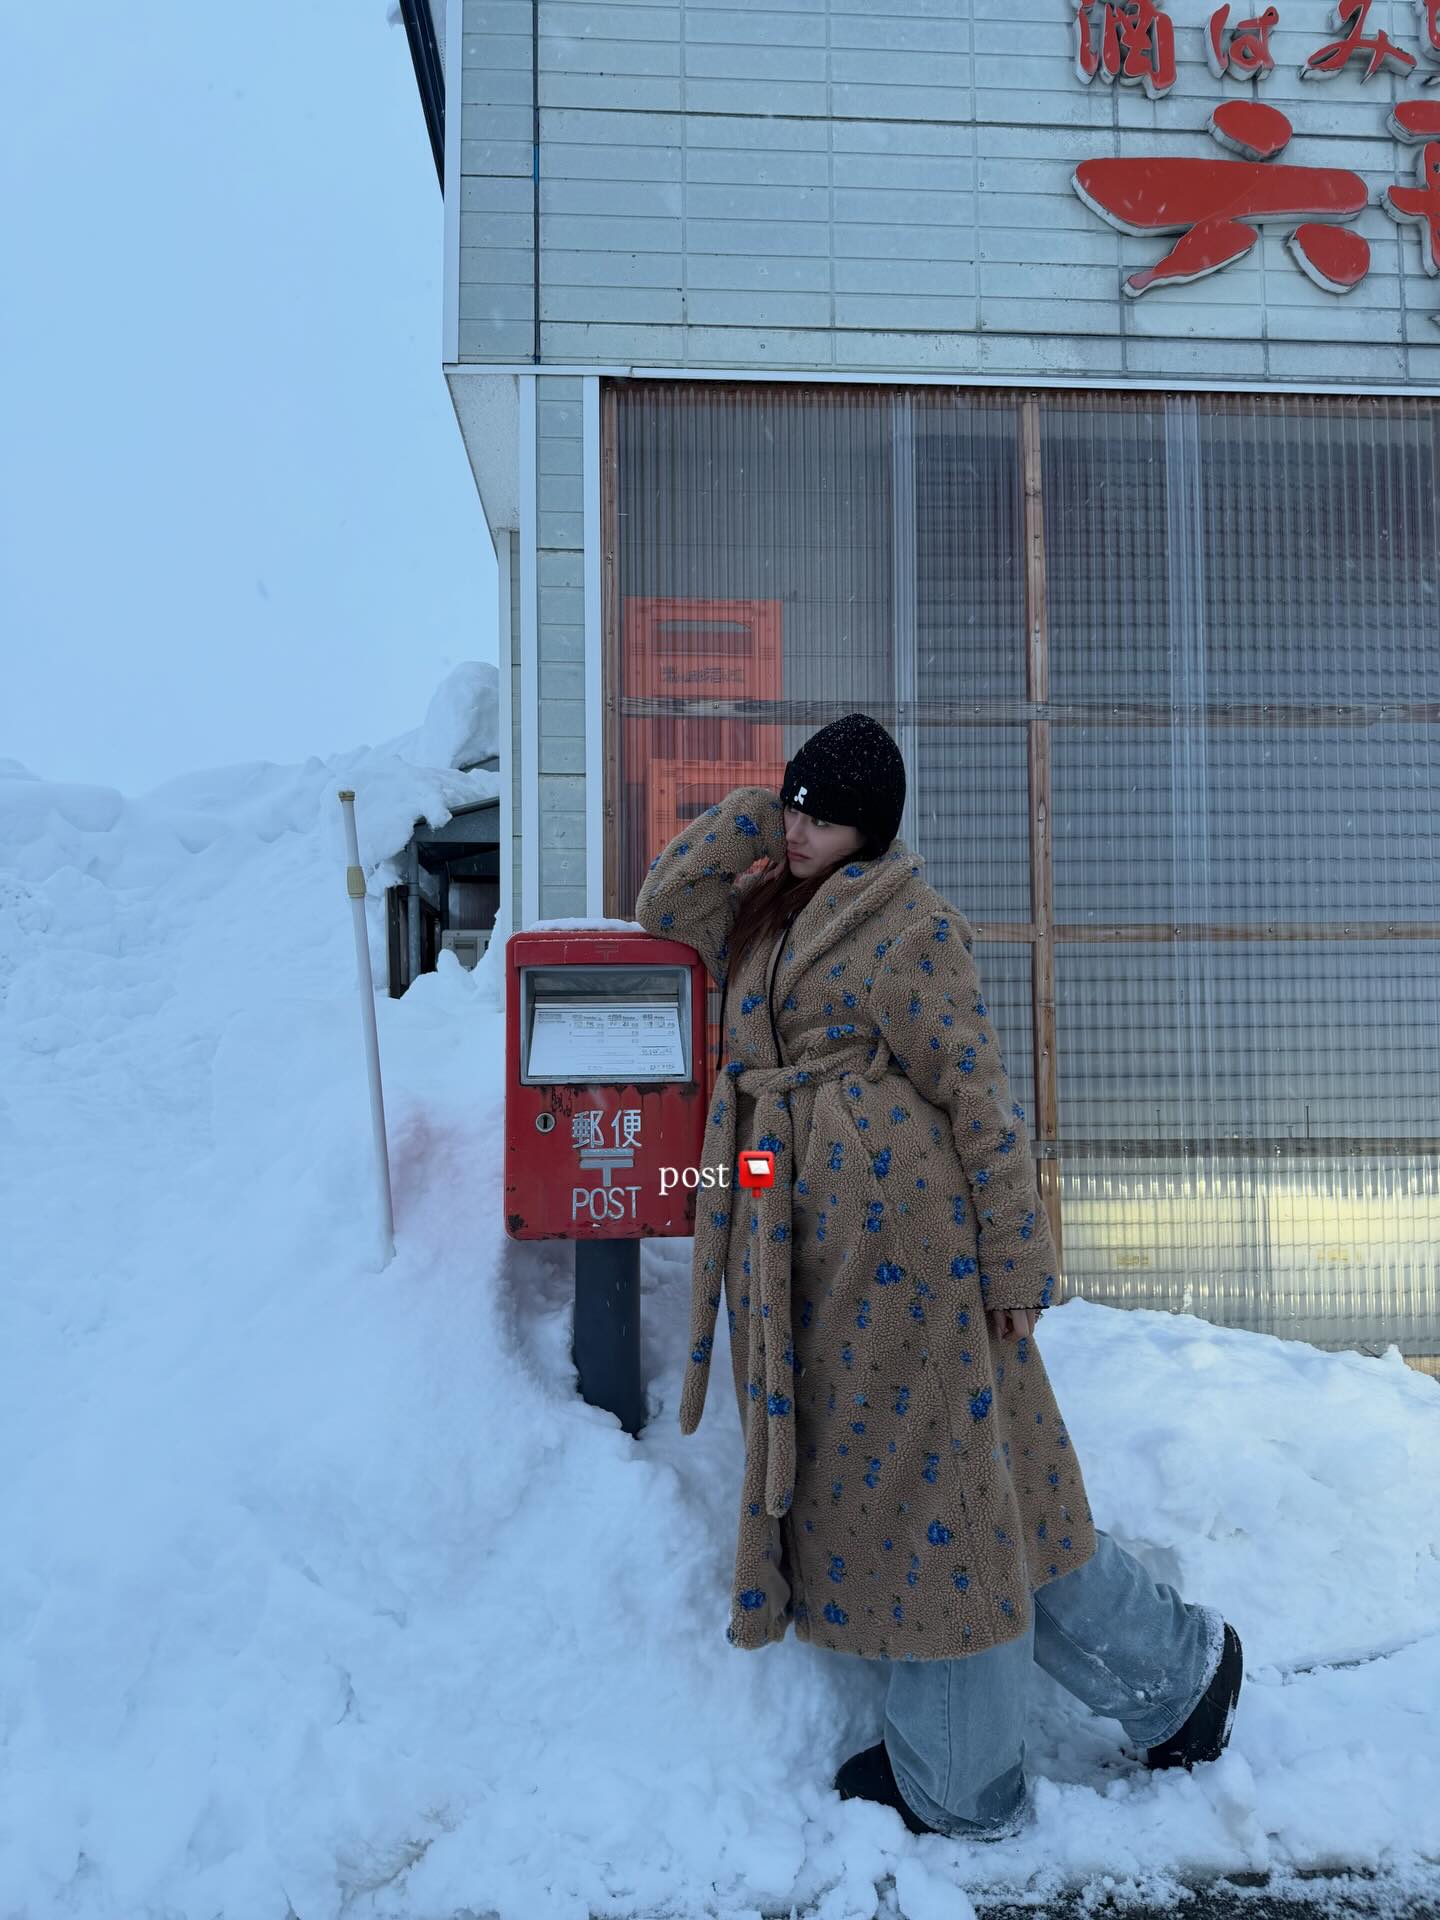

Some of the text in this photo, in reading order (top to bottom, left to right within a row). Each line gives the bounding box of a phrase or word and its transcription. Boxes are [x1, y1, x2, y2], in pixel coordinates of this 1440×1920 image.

[1073, 100, 1440, 295] 六
[572, 1109, 642, 1149] 郵便
[572, 1186, 642, 1221] POST
